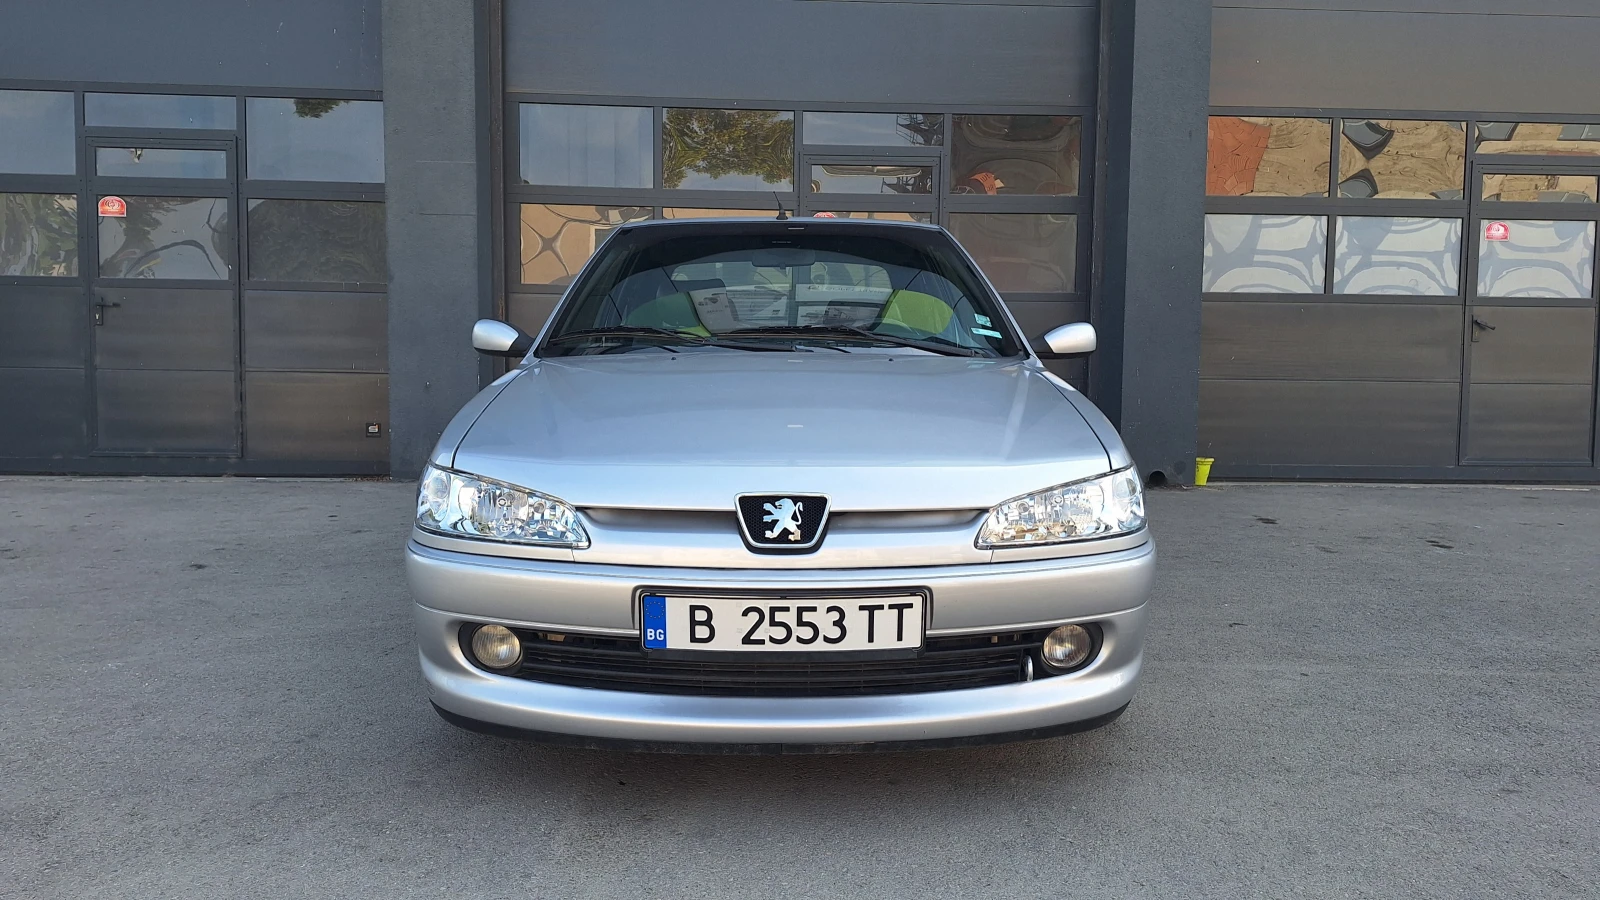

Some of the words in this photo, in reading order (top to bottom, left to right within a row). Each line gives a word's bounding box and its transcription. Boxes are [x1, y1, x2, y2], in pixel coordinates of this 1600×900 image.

[647, 629, 664, 640] BG
[690, 605, 715, 643] B
[742, 606, 847, 645] 2553
[859, 603, 913, 643] TT
